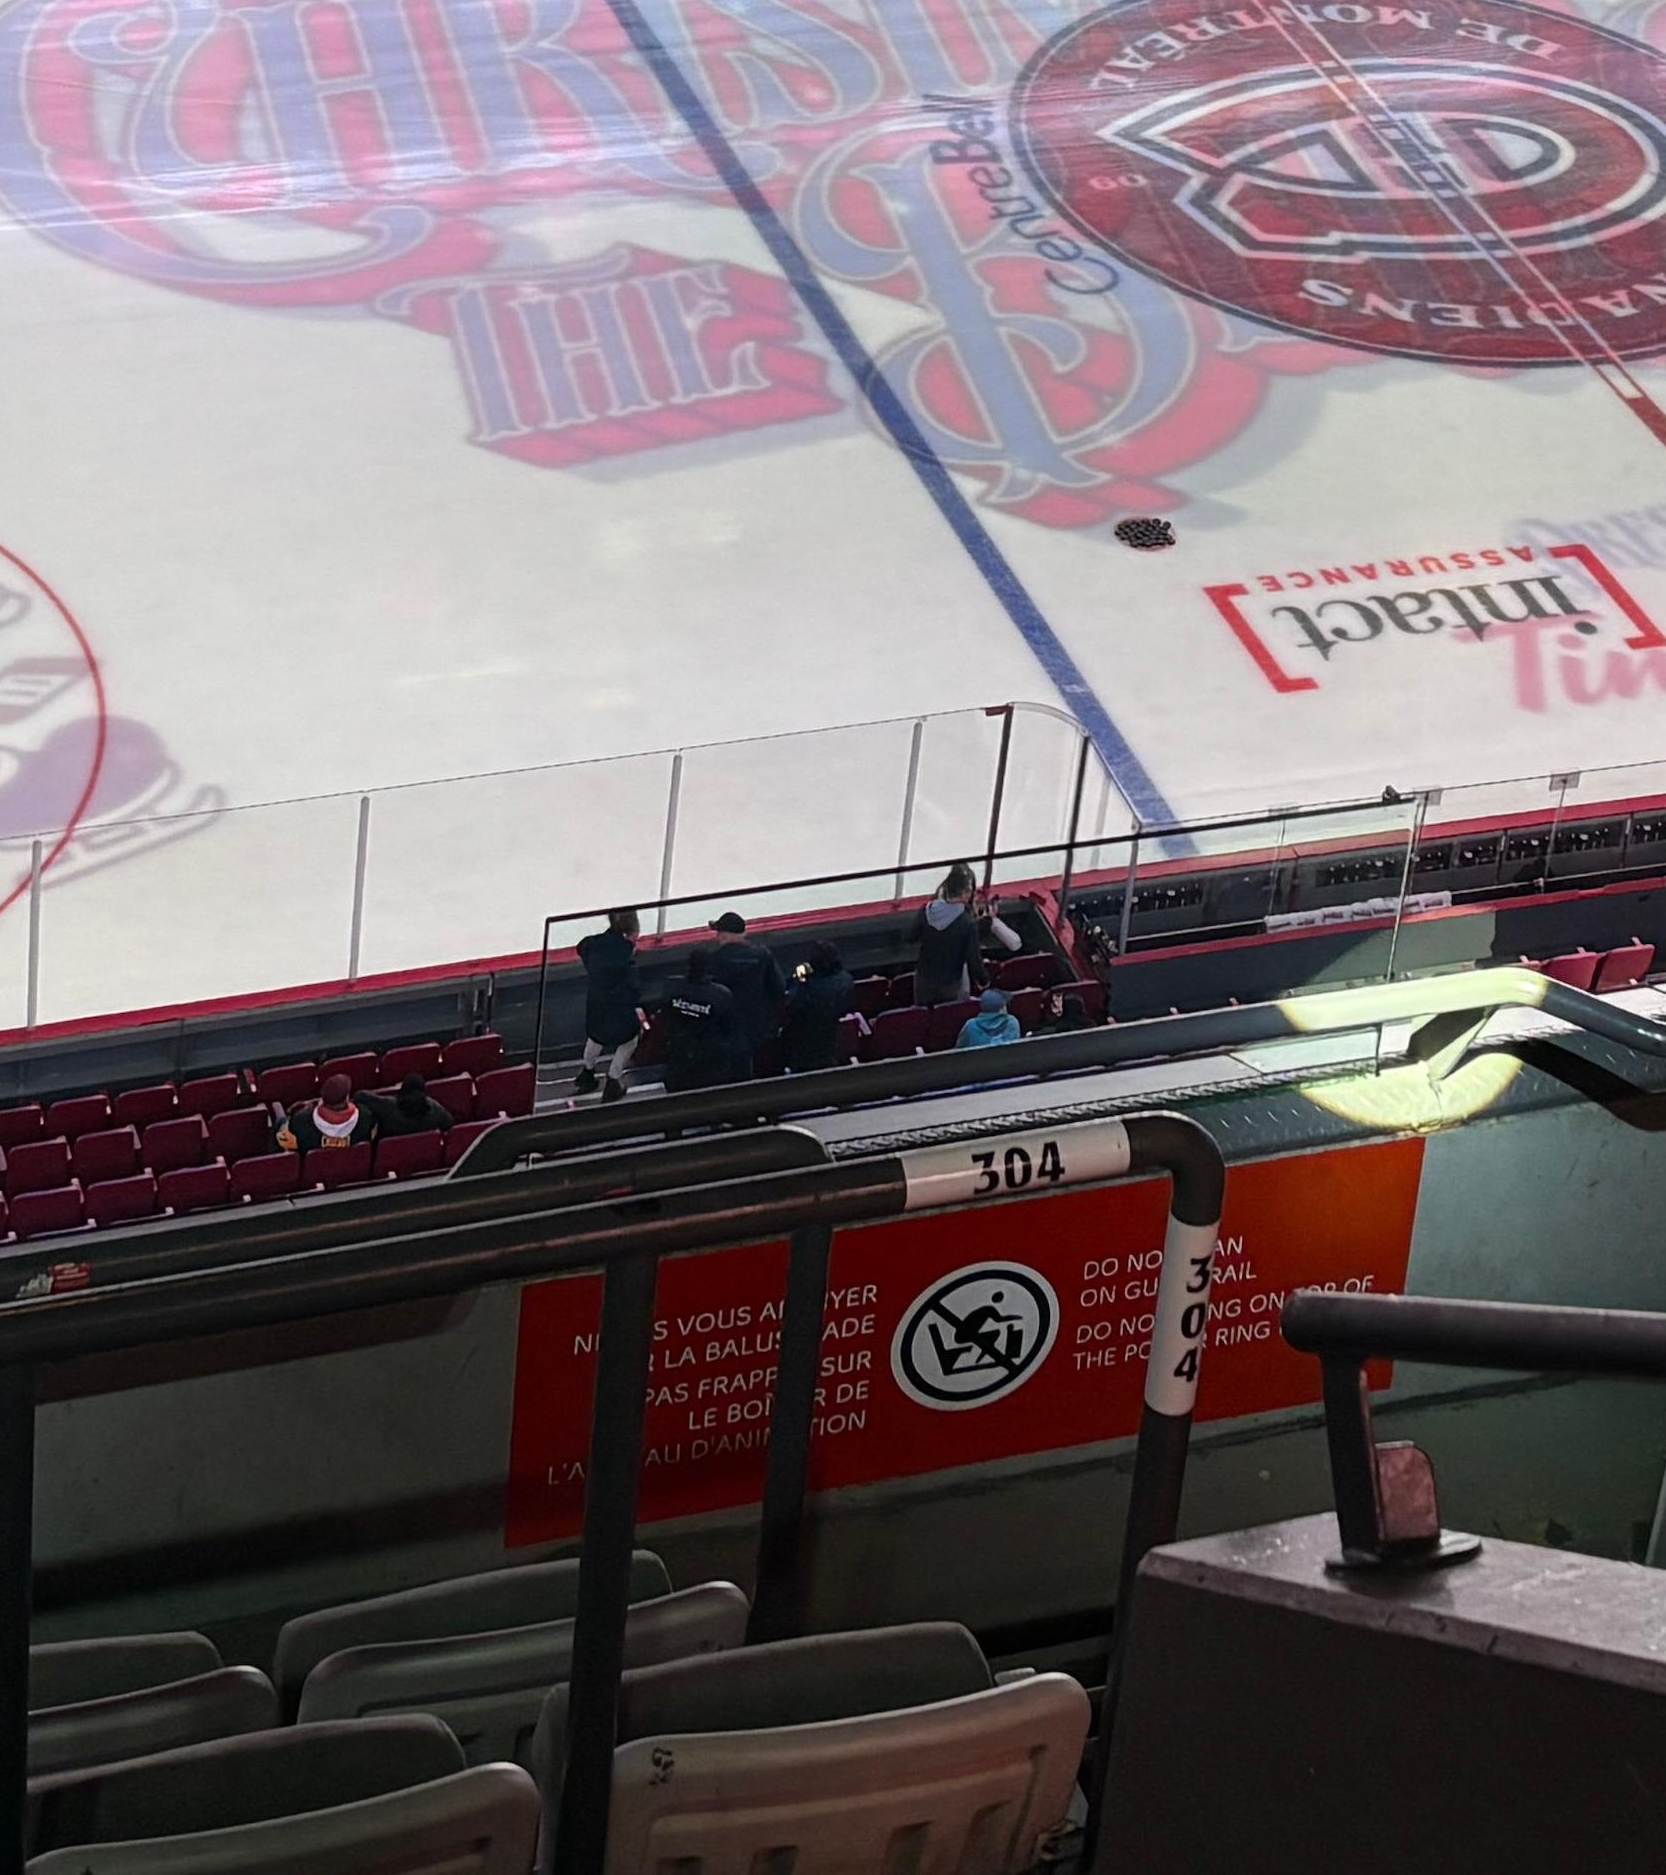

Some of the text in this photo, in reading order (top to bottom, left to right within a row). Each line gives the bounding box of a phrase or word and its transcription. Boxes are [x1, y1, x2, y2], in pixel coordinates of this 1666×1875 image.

[1089, 0, 1571, 93] DE MONTRÉAL
[926, 91, 1121, 299] CentreBell
[369, 244, 844, 468] THE
[1257, 542, 1536, 593] ASSURANCE
[1271, 573, 1600, 663] intact
[969, 1139, 1066, 1195] 304
[1083, 1257, 1119, 1280] DO
[1128, 1248, 1163, 1272] NO
[677, 1305, 751, 1337] VOUS
[1076, 1321, 1112, 1344] DO
[1120, 1312, 1155, 1336] NO
[1249, 1292, 1285, 1314] ON
[1080, 1285, 1116, 1307] ON
[1172, 1255, 1212, 1383] 304
[664, 1345, 696, 1368] LA
[820, 1350, 872, 1376] SUR
[1073, 1320, 1271, 1370] THE RING
[688, 1380, 870, 1430] LE DE
